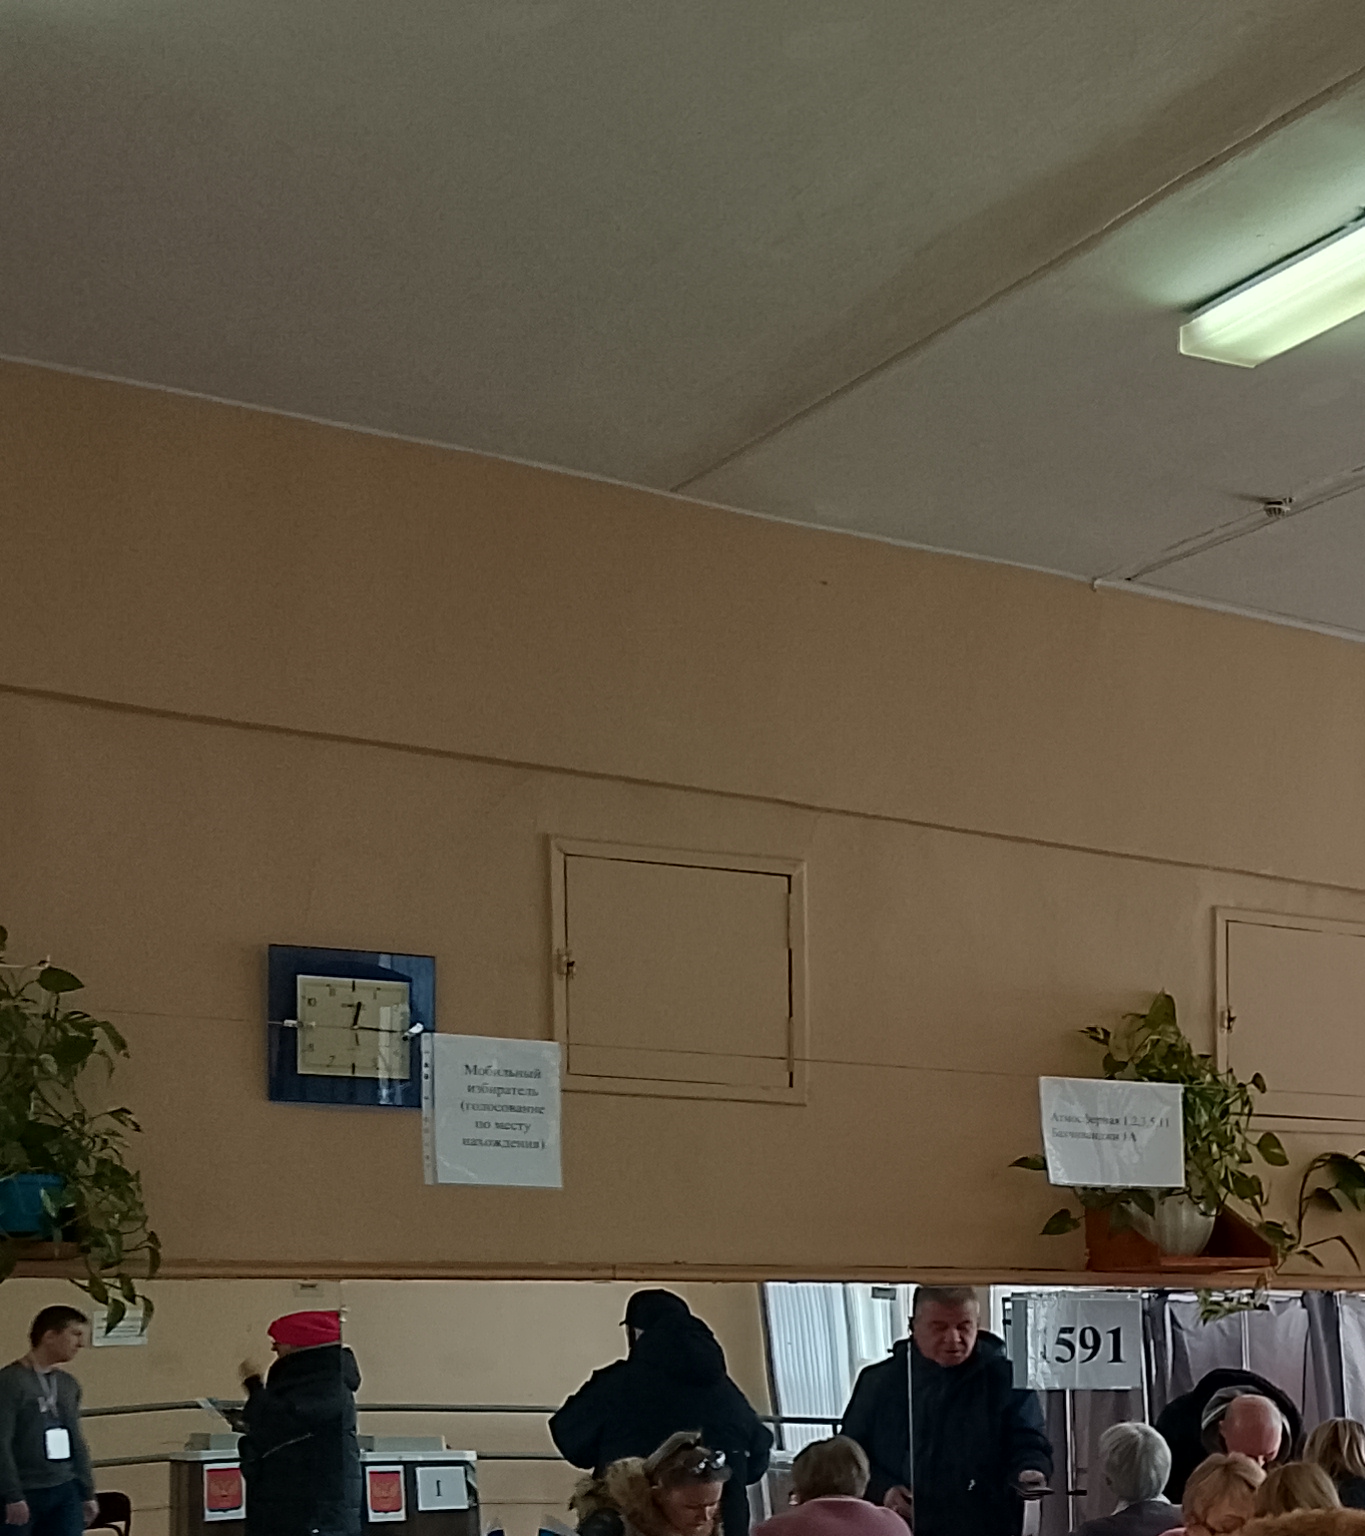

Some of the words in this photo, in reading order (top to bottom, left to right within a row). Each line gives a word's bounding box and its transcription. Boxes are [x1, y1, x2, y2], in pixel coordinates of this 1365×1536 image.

[464, 1063, 541, 1079] Мобильный
[467, 1082, 539, 1097] избиратель
[475, 1120, 491, 1129] по
[495, 1121, 531, 1135] месту
